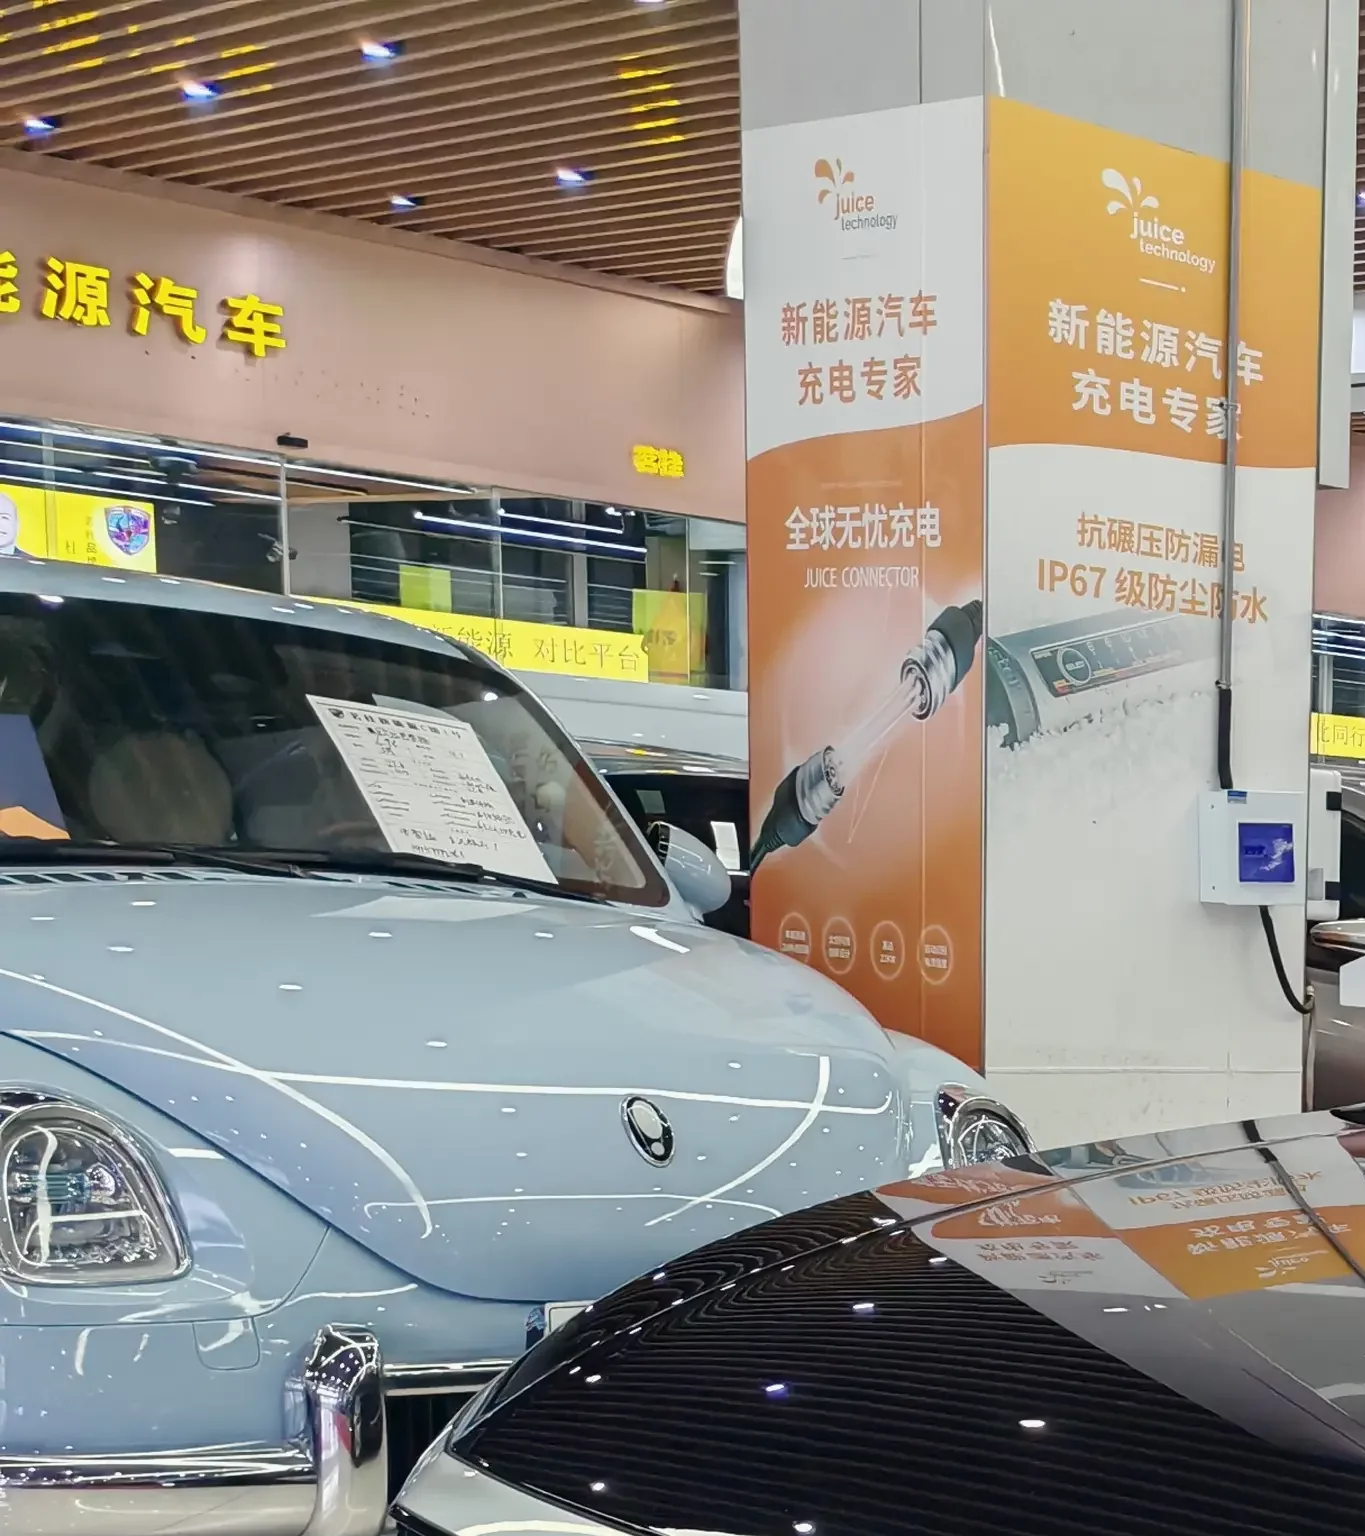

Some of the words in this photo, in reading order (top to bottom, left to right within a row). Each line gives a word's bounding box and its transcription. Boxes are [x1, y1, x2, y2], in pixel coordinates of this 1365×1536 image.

[835, 193, 874, 221] juice
[841, 212, 898, 232] technology
[1130, 212, 1185, 245] juice
[1139, 240, 1216, 273] technology
[781, 290, 938, 346] 新能源汽车
[1048, 298, 1263, 386] 新能源汽车
[796, 354, 923, 406] 充电专家
[1071, 368, 1242, 441] 充电专家
[784, 500, 942, 553] 全球无忧充电
[804, 567, 837, 588] JUICE
[842, 566, 919, 588] CONNECTOR
[1038, 558, 1107, 598] IP67
[534, 637, 639, 672] 对比平台
